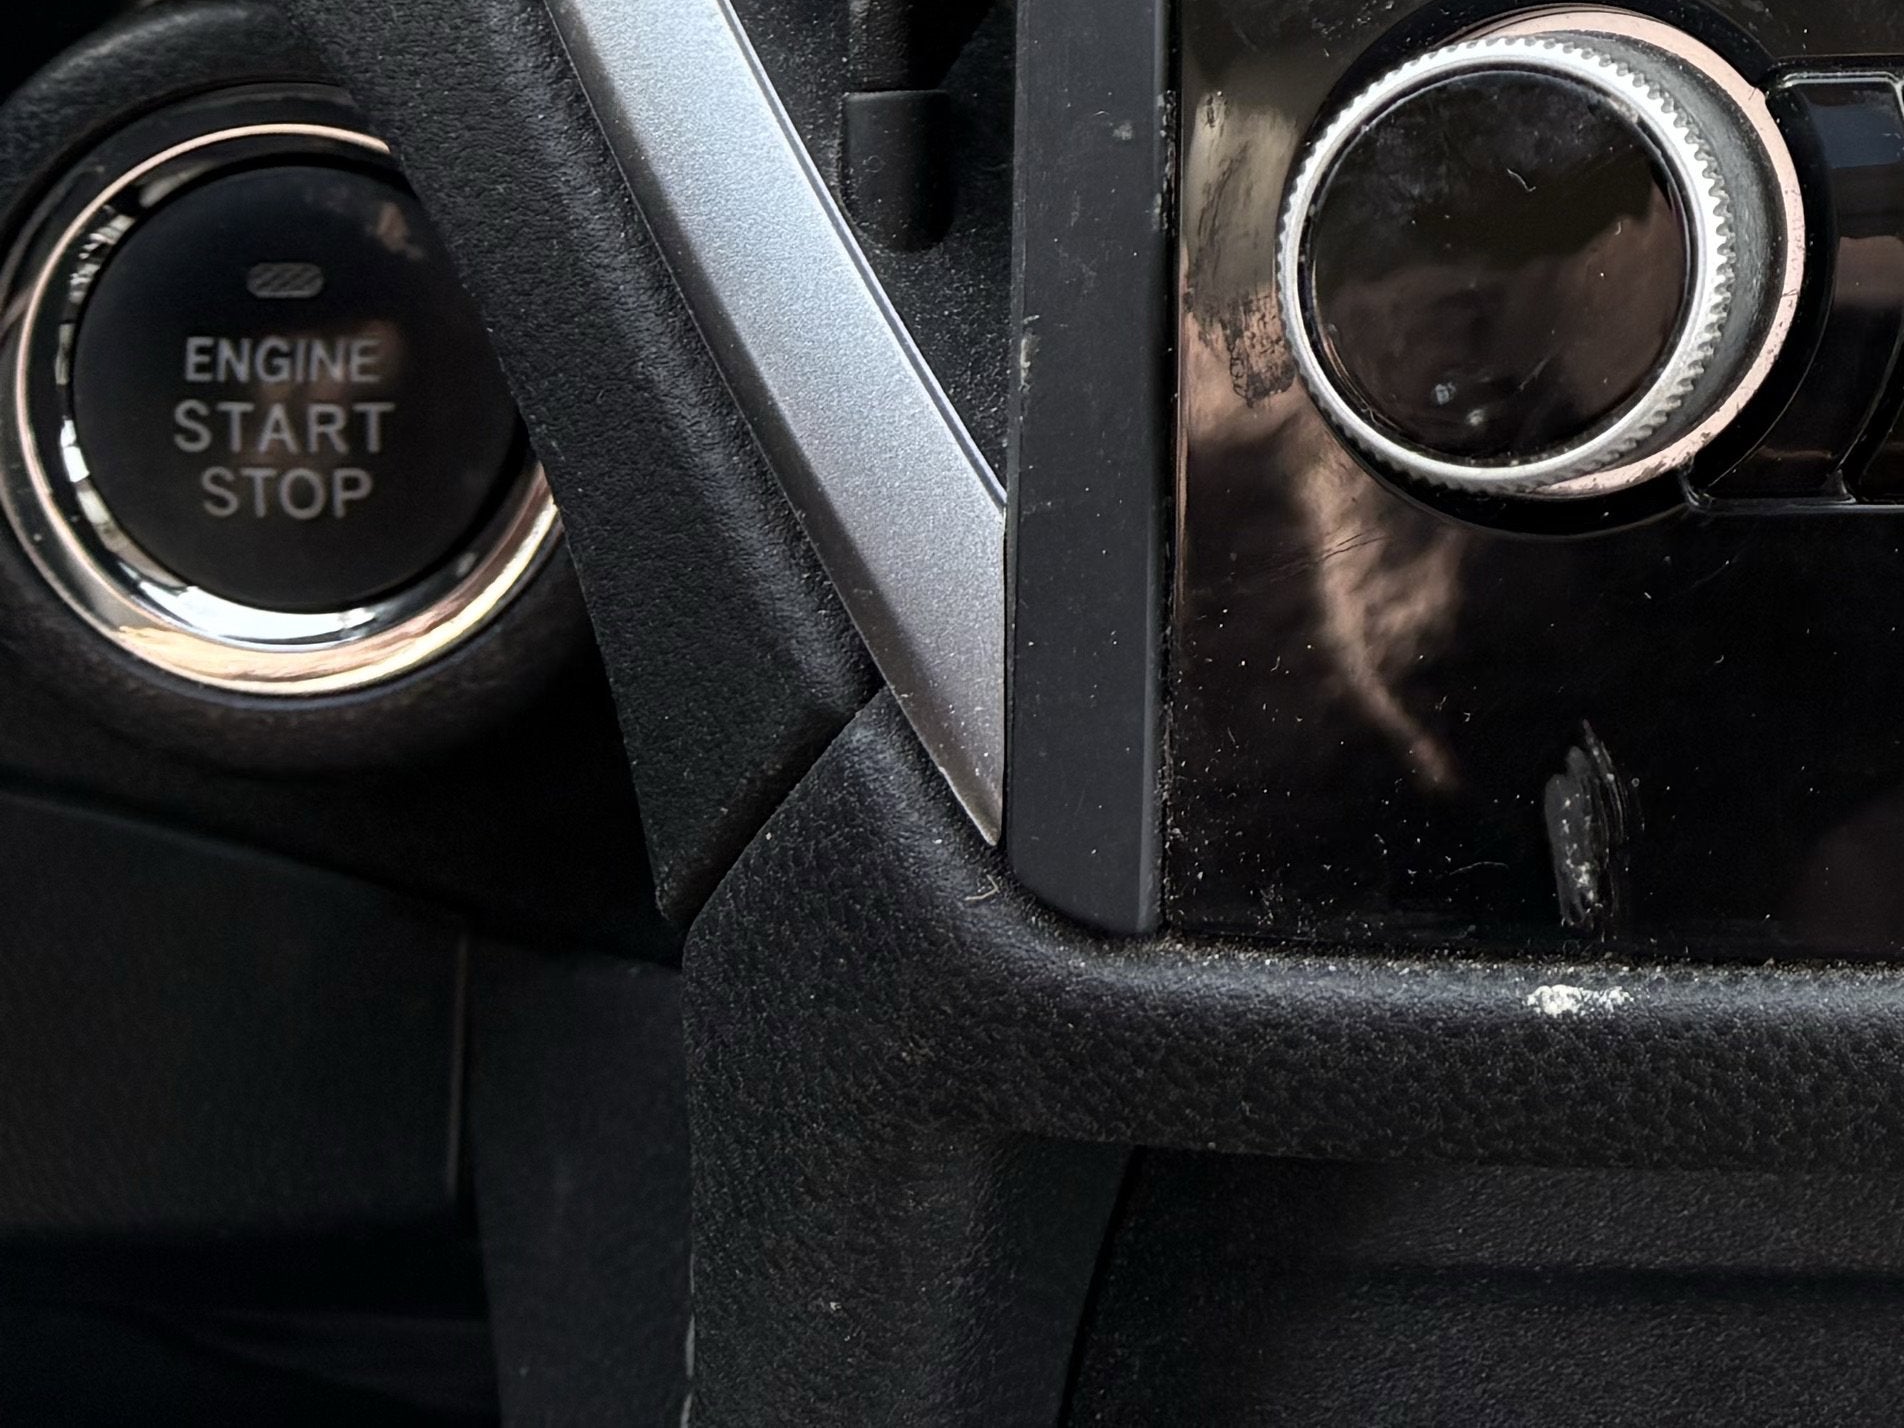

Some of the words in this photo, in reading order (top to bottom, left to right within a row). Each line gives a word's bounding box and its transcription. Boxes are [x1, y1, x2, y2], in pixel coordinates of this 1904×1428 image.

[184, 336, 384, 384] ENGINE
[173, 401, 396, 454] START
[202, 466, 374, 520] STOP
